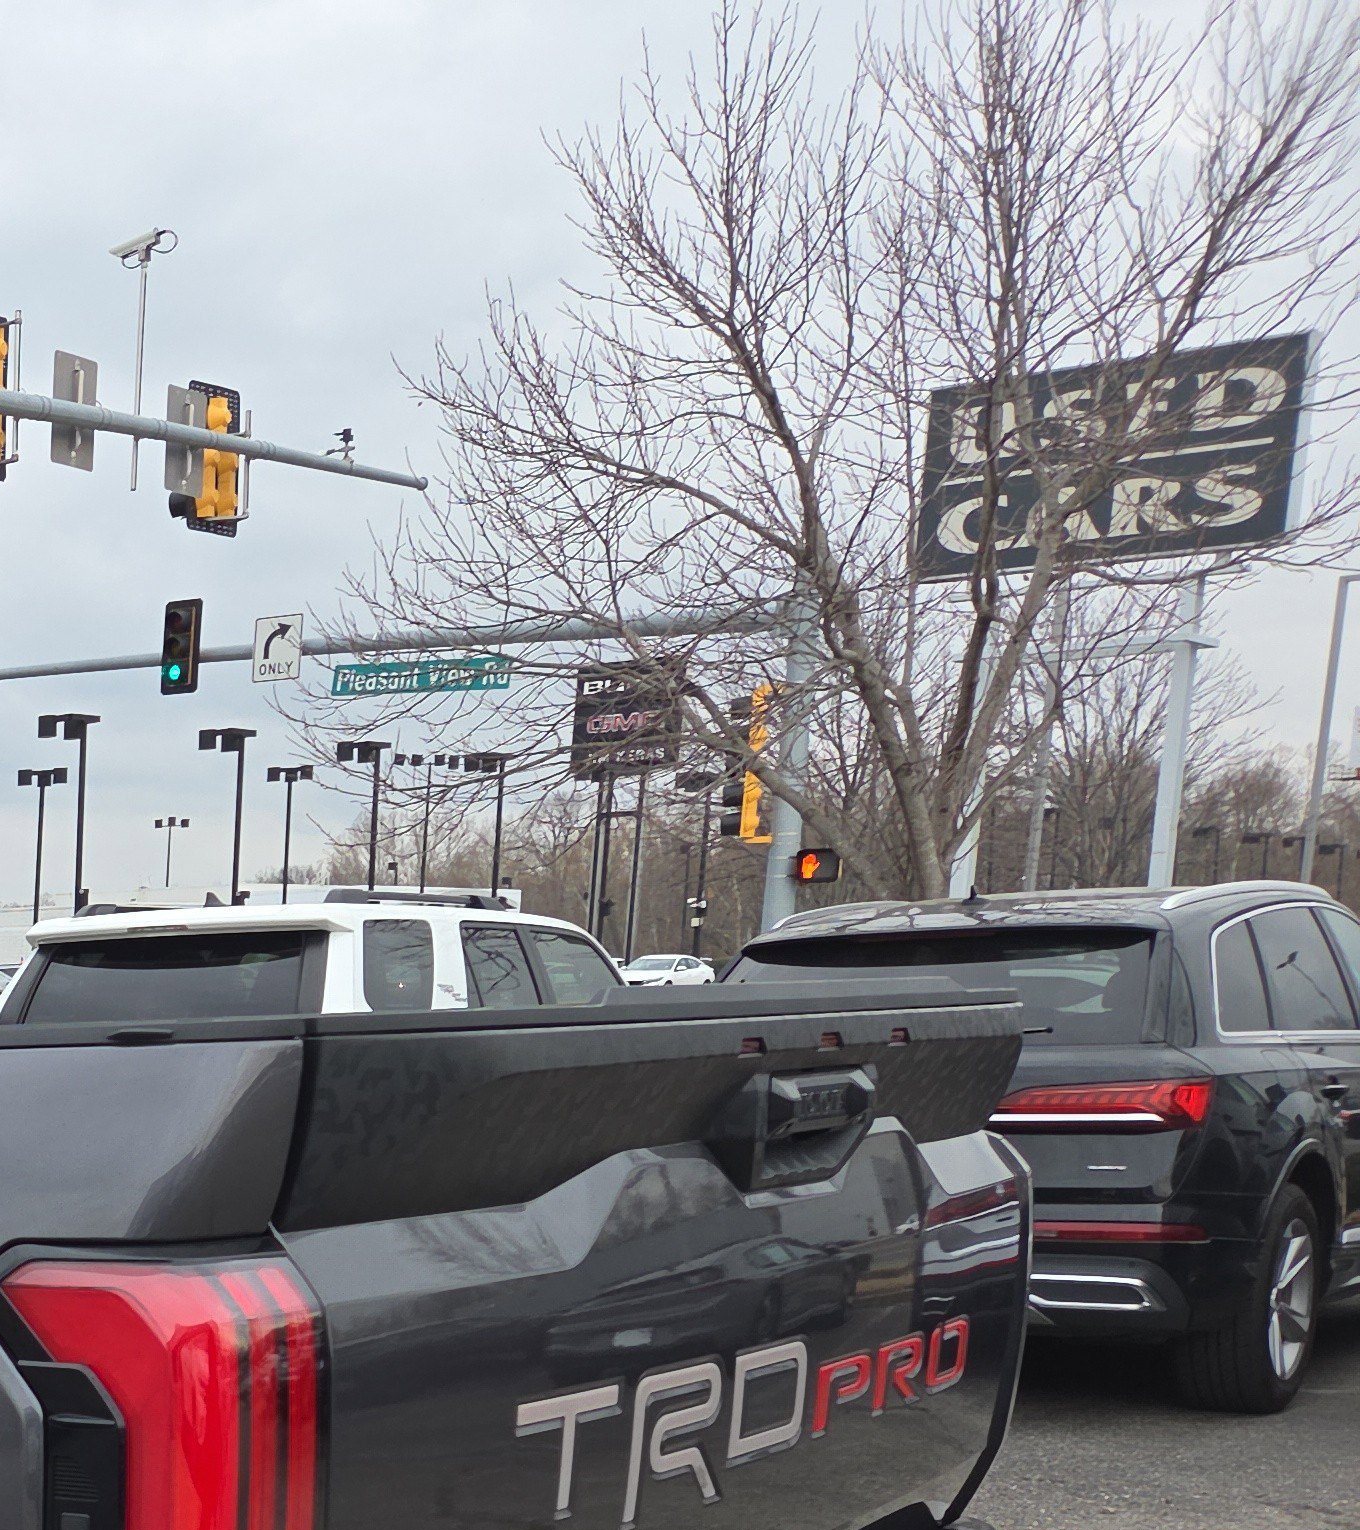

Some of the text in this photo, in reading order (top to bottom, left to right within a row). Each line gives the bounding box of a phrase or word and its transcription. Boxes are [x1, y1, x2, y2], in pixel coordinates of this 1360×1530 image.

[950, 366, 1287, 464] USED
[937, 464, 1264, 554] CARS
[259, 660, 293, 676] ONLY
[336, 667, 419, 692] Pleasant
[515, 1314, 970, 1530] TRD PRO
